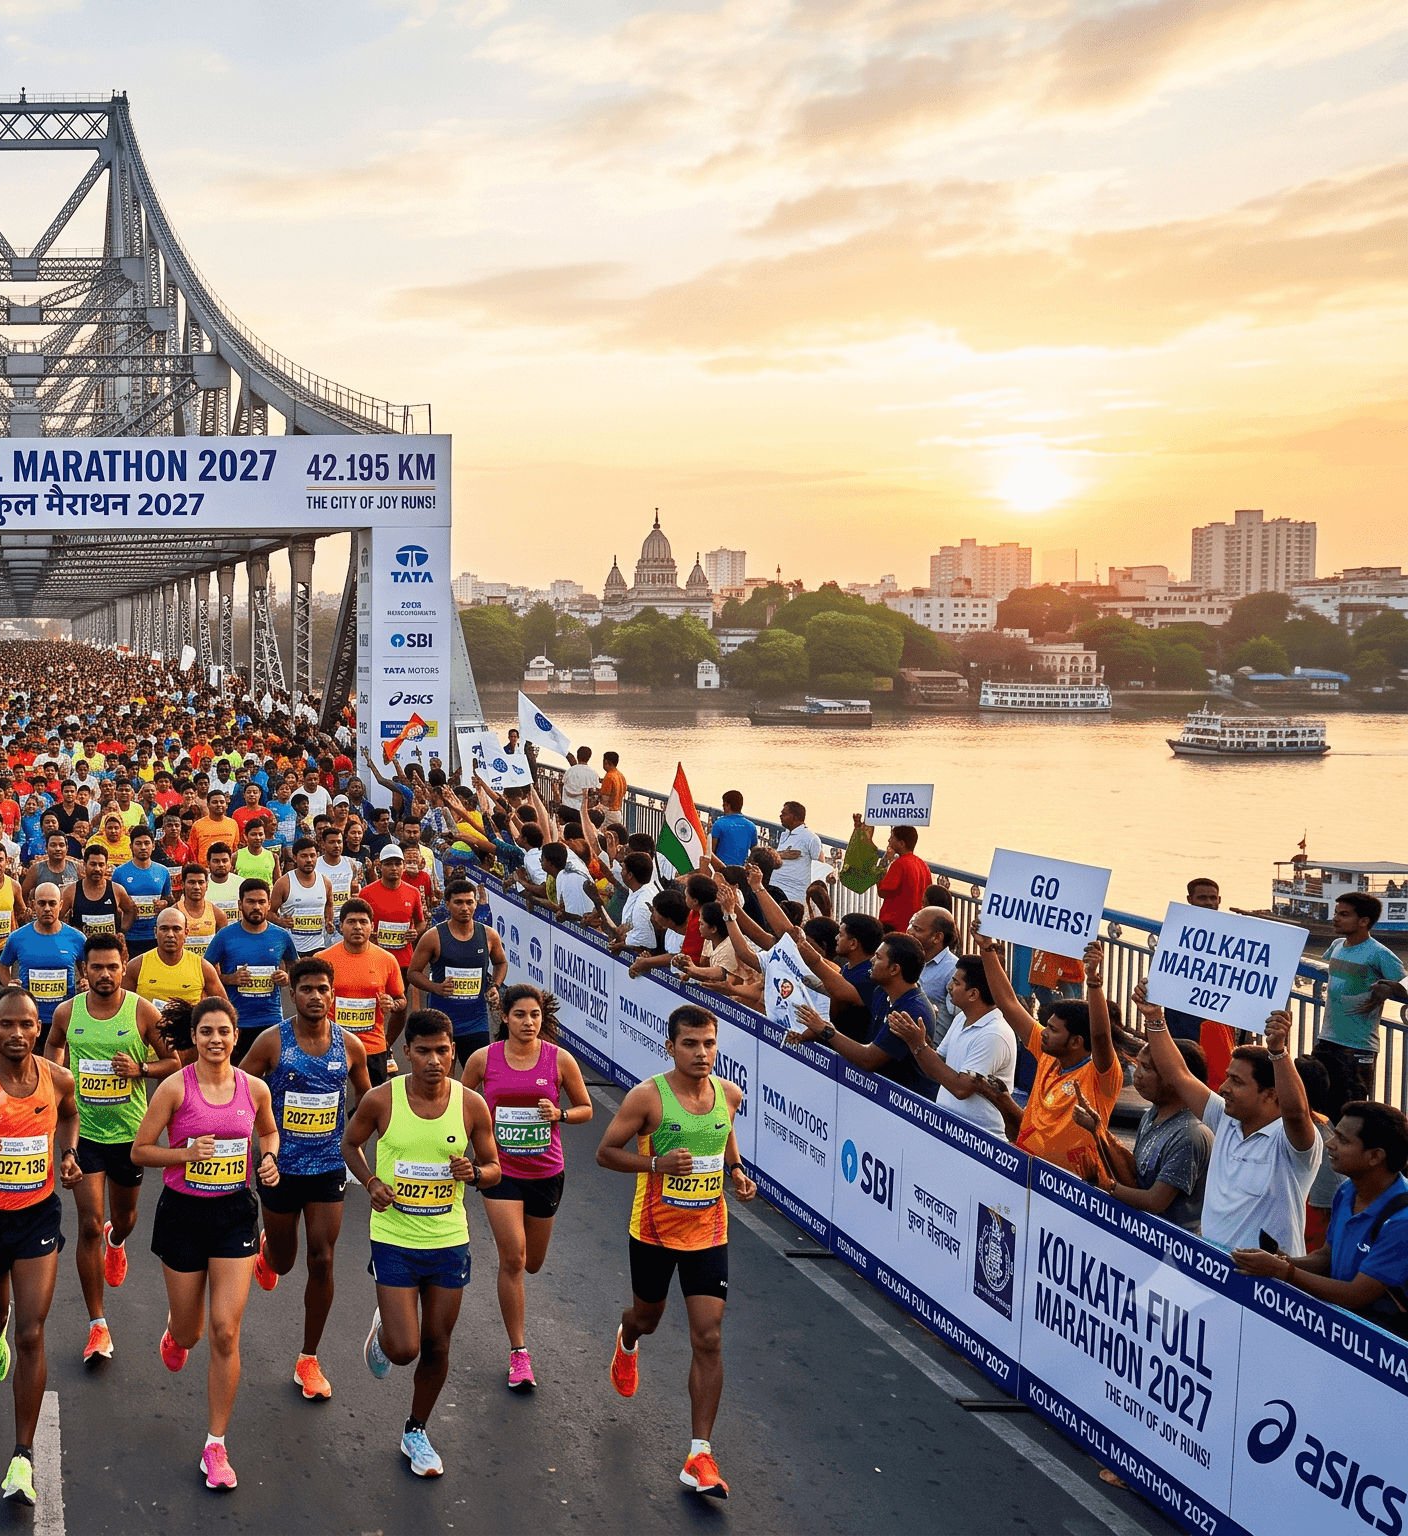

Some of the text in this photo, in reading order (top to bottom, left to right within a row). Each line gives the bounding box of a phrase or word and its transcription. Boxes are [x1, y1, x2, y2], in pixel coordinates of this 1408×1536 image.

[13, 450, 187, 482] MARATHON
[198, 449, 277, 481] 2027
[306, 453, 436, 481] 42.195 KM
[44, 483, 131, 516] मैराथन
[137, 493, 205, 516] 2027
[306, 495, 436, 509] THE CITY OF JOY RUNS!
[391, 571, 434, 583] TATA
[406, 633, 433, 648] SBI
[403, 693, 434, 705] asics
[882, 792, 915, 805] GATA
[1030, 874, 1060, 901] GO
[986, 893, 1093, 938] RUNNERS!
[1178, 925, 1271, 968] KOLKATA
[1158, 950, 1278, 1000] MARATHON
[620, 995, 639, 1020] TATA
[1189, 987, 1232, 1013] 2027
[762, 1084, 786, 1115] TATA
[788, 1101, 828, 1141] MOTORS
[888, 1090, 924, 1122] KOLKATA
[945, 1121, 994, 1159] MARATHON
[995, 1148, 1020, 1173] 2027
[860, 1151, 895, 1211] SBI
[1039, 1169, 1231, 1285] KOLKATA FULL MARATHON 2027
[1038, 1226, 1213, 1380] KOLKATA FULL
[1253, 1280, 1326, 1338] KOLKATA
[1330, 1322, 1374, 1364] FULL
[933, 1310, 985, 1361] MARATHON
[986, 1350, 1010, 1380] 2027
[1035, 1280, 1213, 1433] MARATHON 2027
[1104, 1380, 1211, 1470] THE CITY OF JOY RUNS!
[1028, 1383, 1217, 1536] KOLKATA FULL MARATHON 2027
[1294, 1433, 1408, 1536] asics
